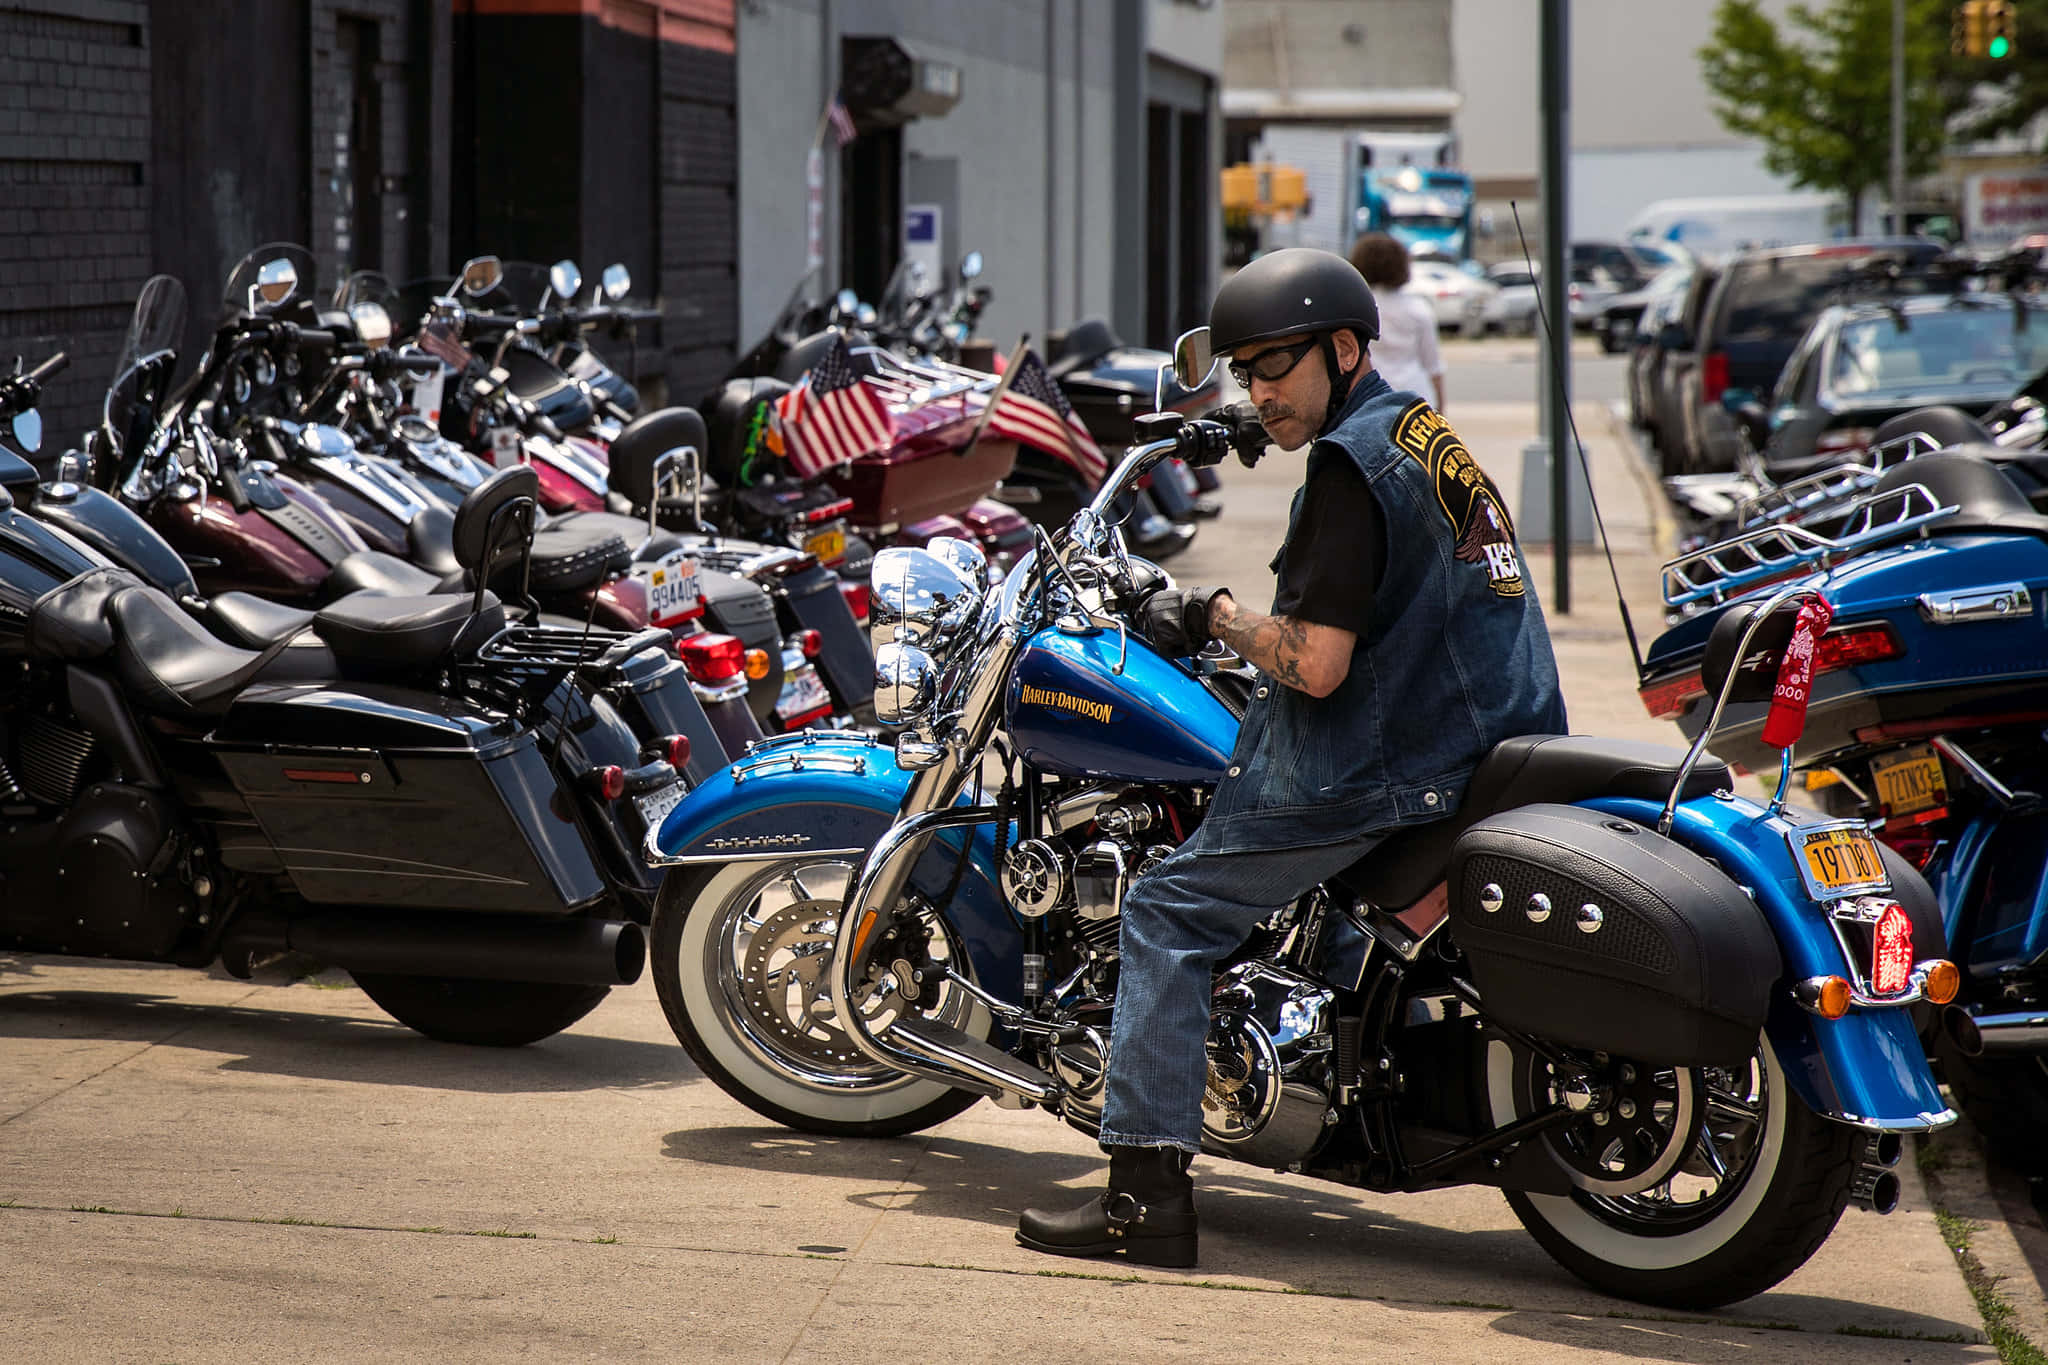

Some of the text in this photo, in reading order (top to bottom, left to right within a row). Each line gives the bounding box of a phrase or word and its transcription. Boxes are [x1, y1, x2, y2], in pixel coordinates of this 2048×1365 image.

[652, 575, 702, 609] 994405
[1021, 684, 1113, 724] HARLEY-DAVIDSON
[1883, 763, 1935, 801] 72TN33
[714, 834, 802, 849] DELUXE
[1812, 844, 1877, 882] 19TD81
